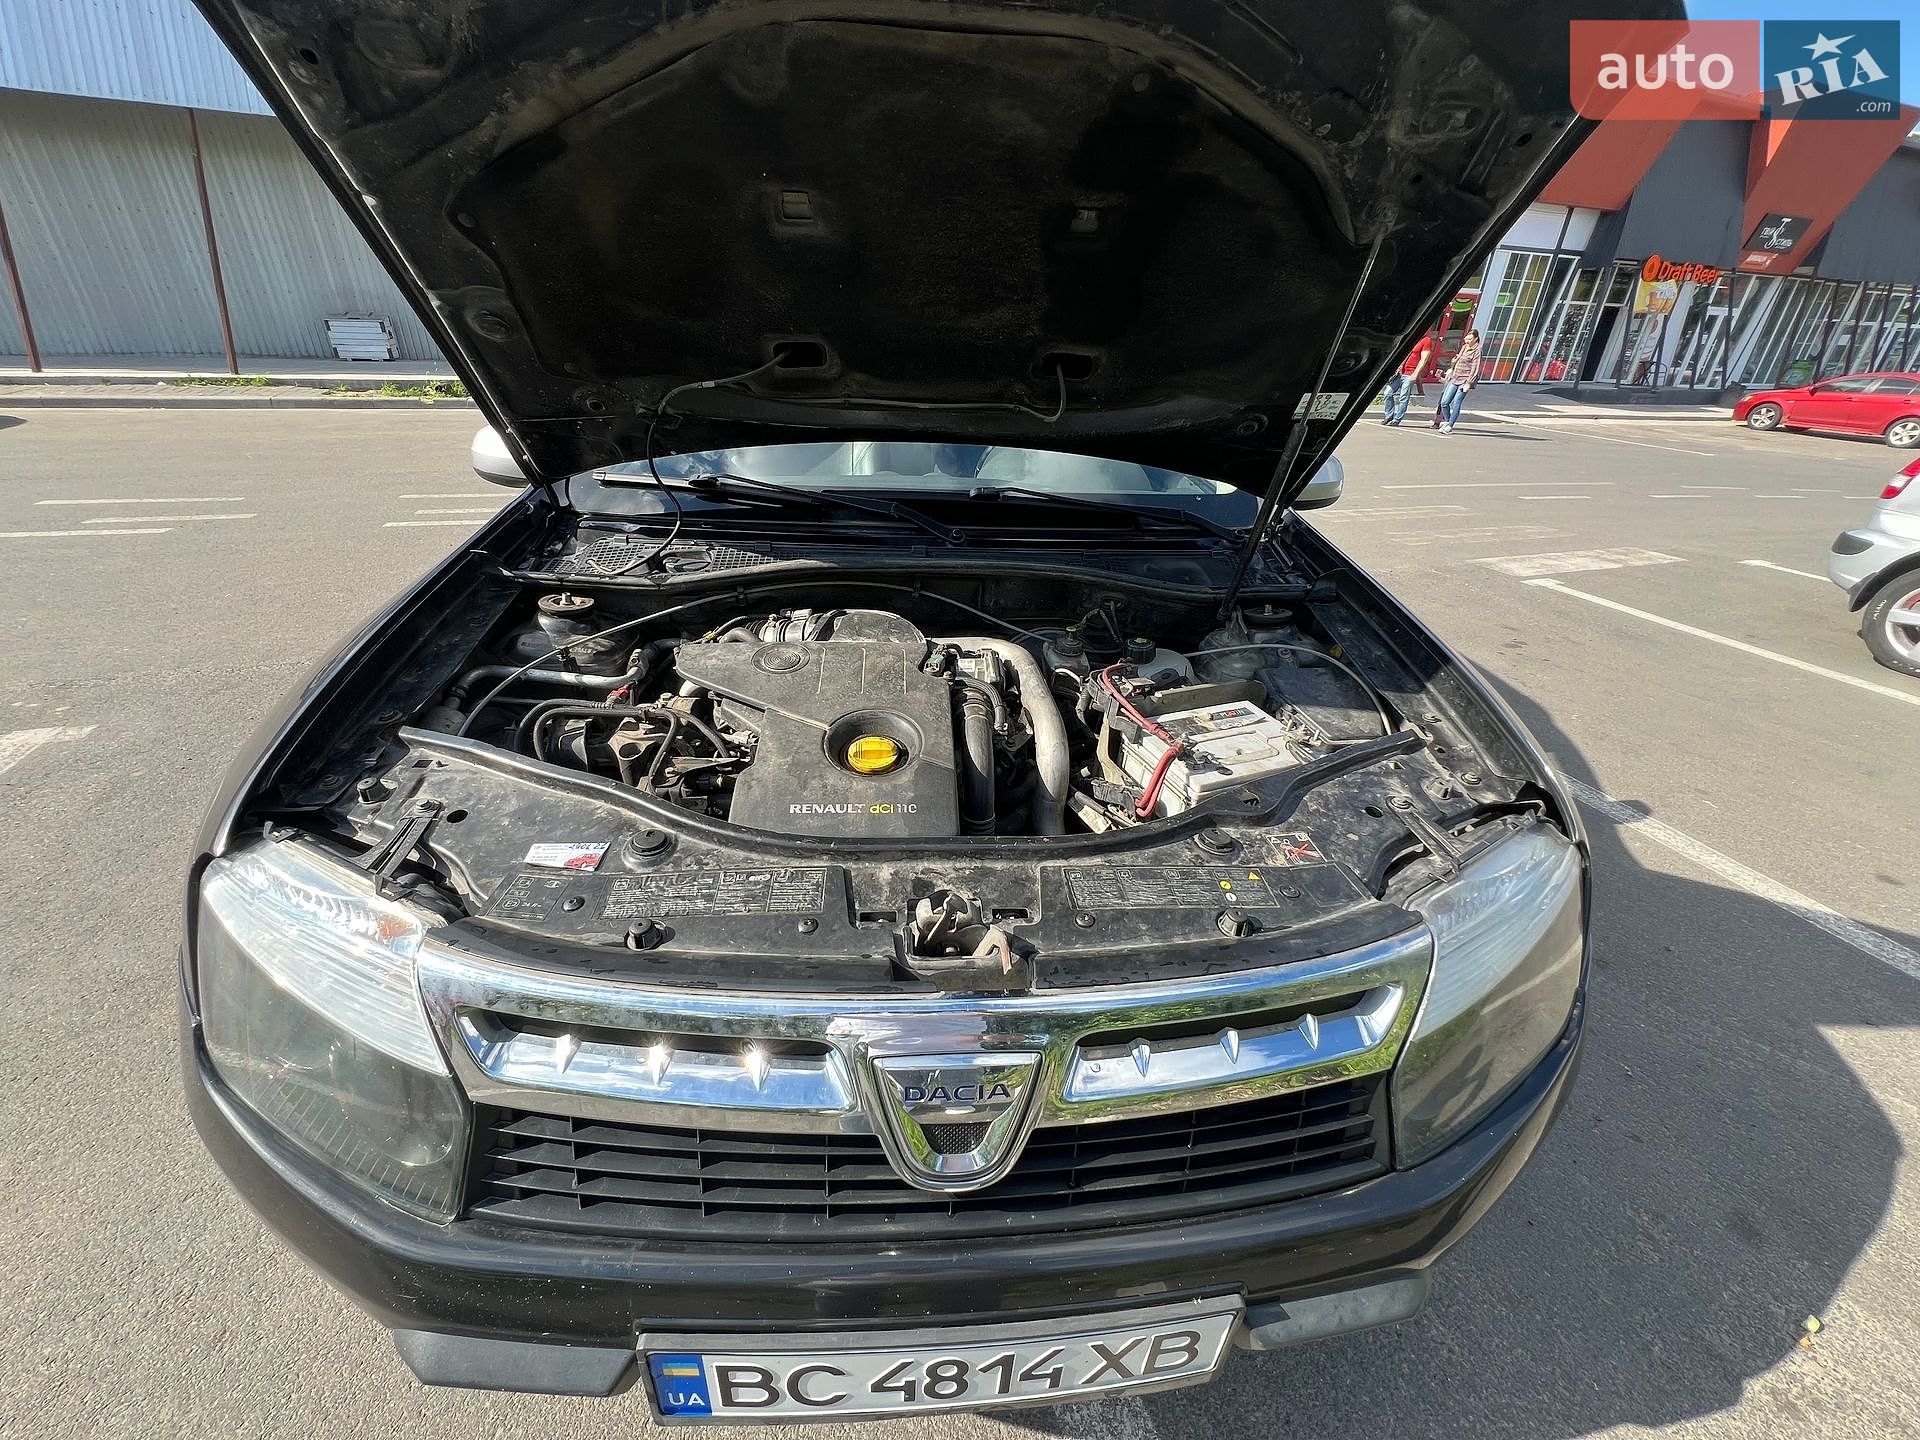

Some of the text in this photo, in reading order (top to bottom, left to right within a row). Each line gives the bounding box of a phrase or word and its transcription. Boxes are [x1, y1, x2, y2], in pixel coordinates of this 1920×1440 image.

[1658, 261, 1719, 285] Draft Beer
[789, 803, 866, 814] RENAULT
[904, 1083, 1011, 1102] DACIA
[714, 1330, 1202, 1408] BC 4814 XB
[668, 1392, 706, 1407] UA
